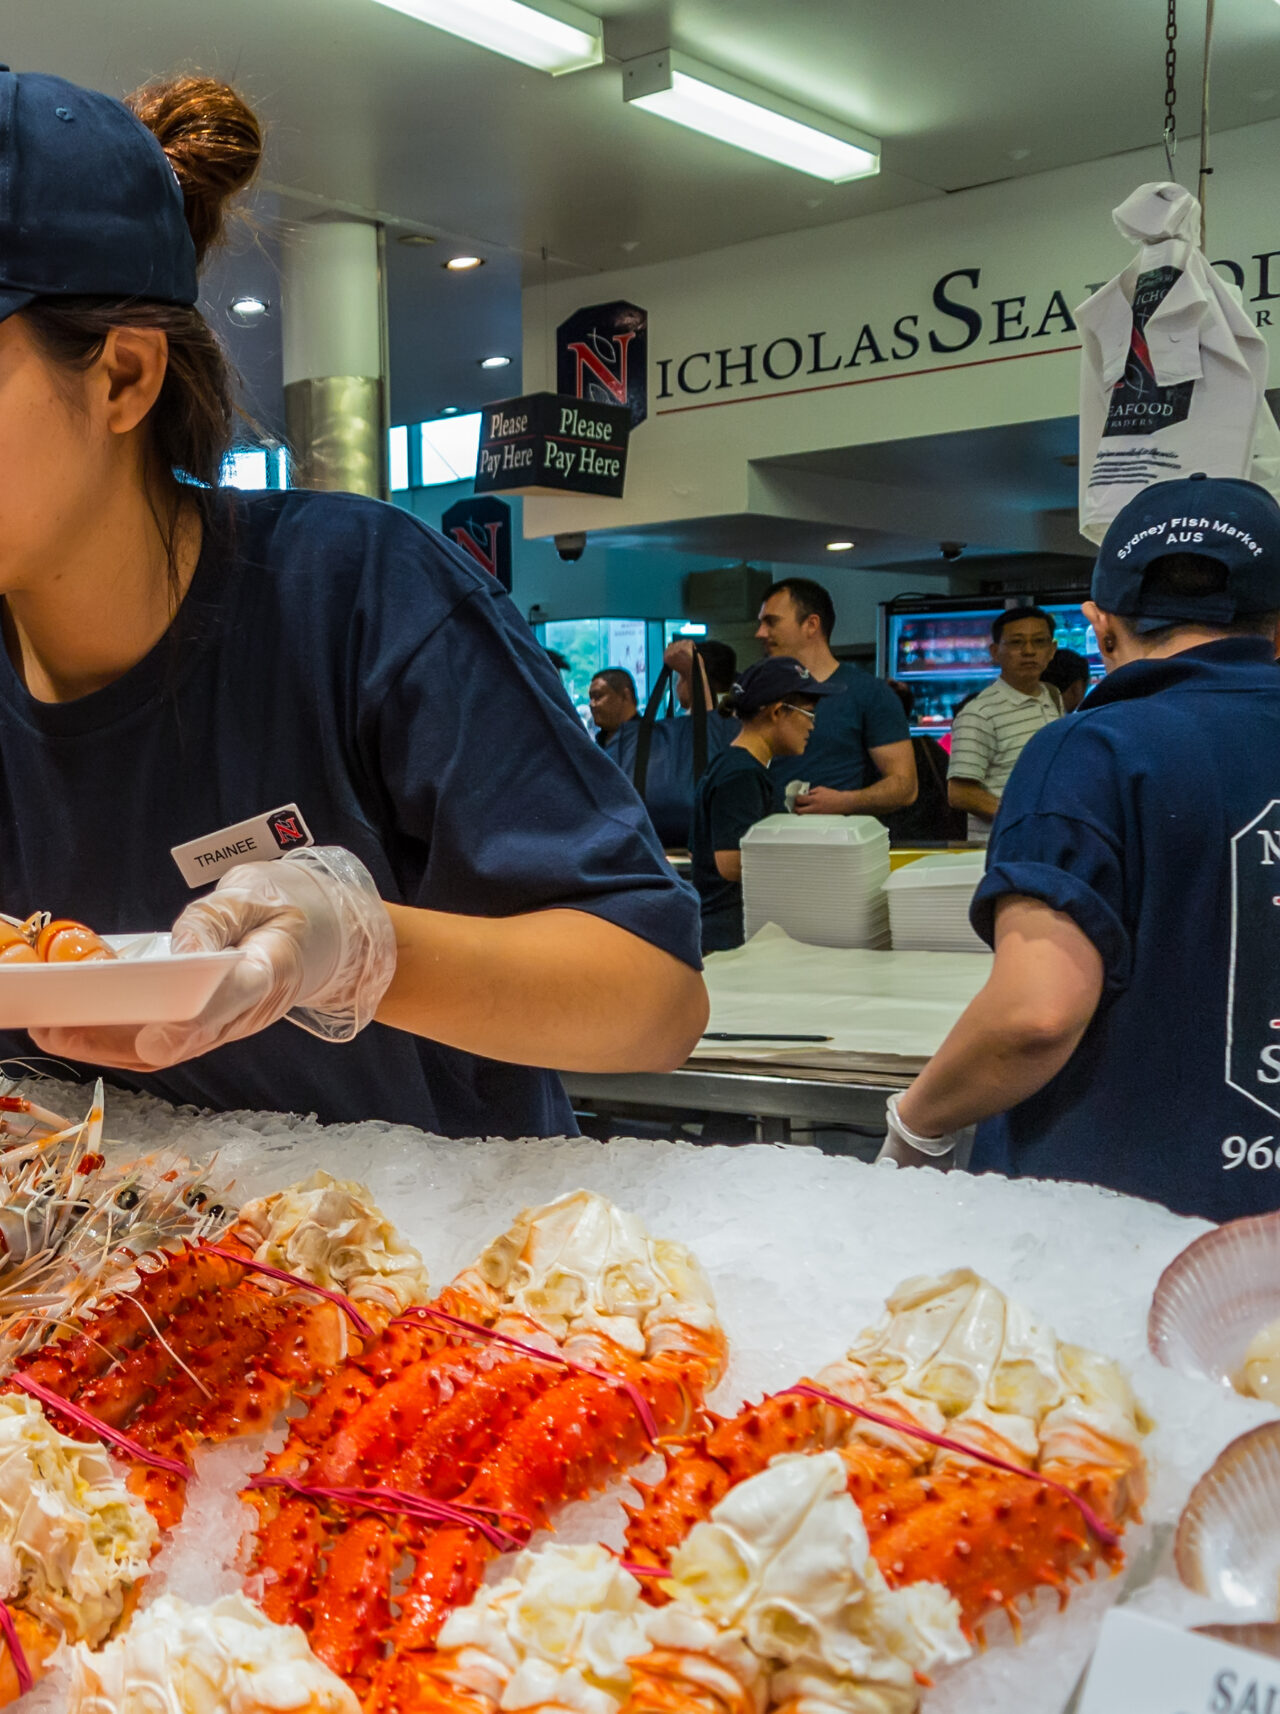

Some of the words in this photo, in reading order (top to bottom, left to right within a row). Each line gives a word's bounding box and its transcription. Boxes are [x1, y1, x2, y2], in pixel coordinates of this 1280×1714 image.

[560, 408, 613, 441] Please
[1109, 402, 1174, 417] EAFOOD
[490, 412, 528, 439] Please
[480, 449, 501, 479] Pay
[502, 444, 533, 470] Here
[544, 441, 576, 478] Pay
[579, 447, 621, 478] Here
[1116, 522, 1167, 560] Sydney
[1212, 520, 1264, 557] Market
[1166, 532, 1204, 545] AUS
[194, 837, 258, 867] TRAINEE
